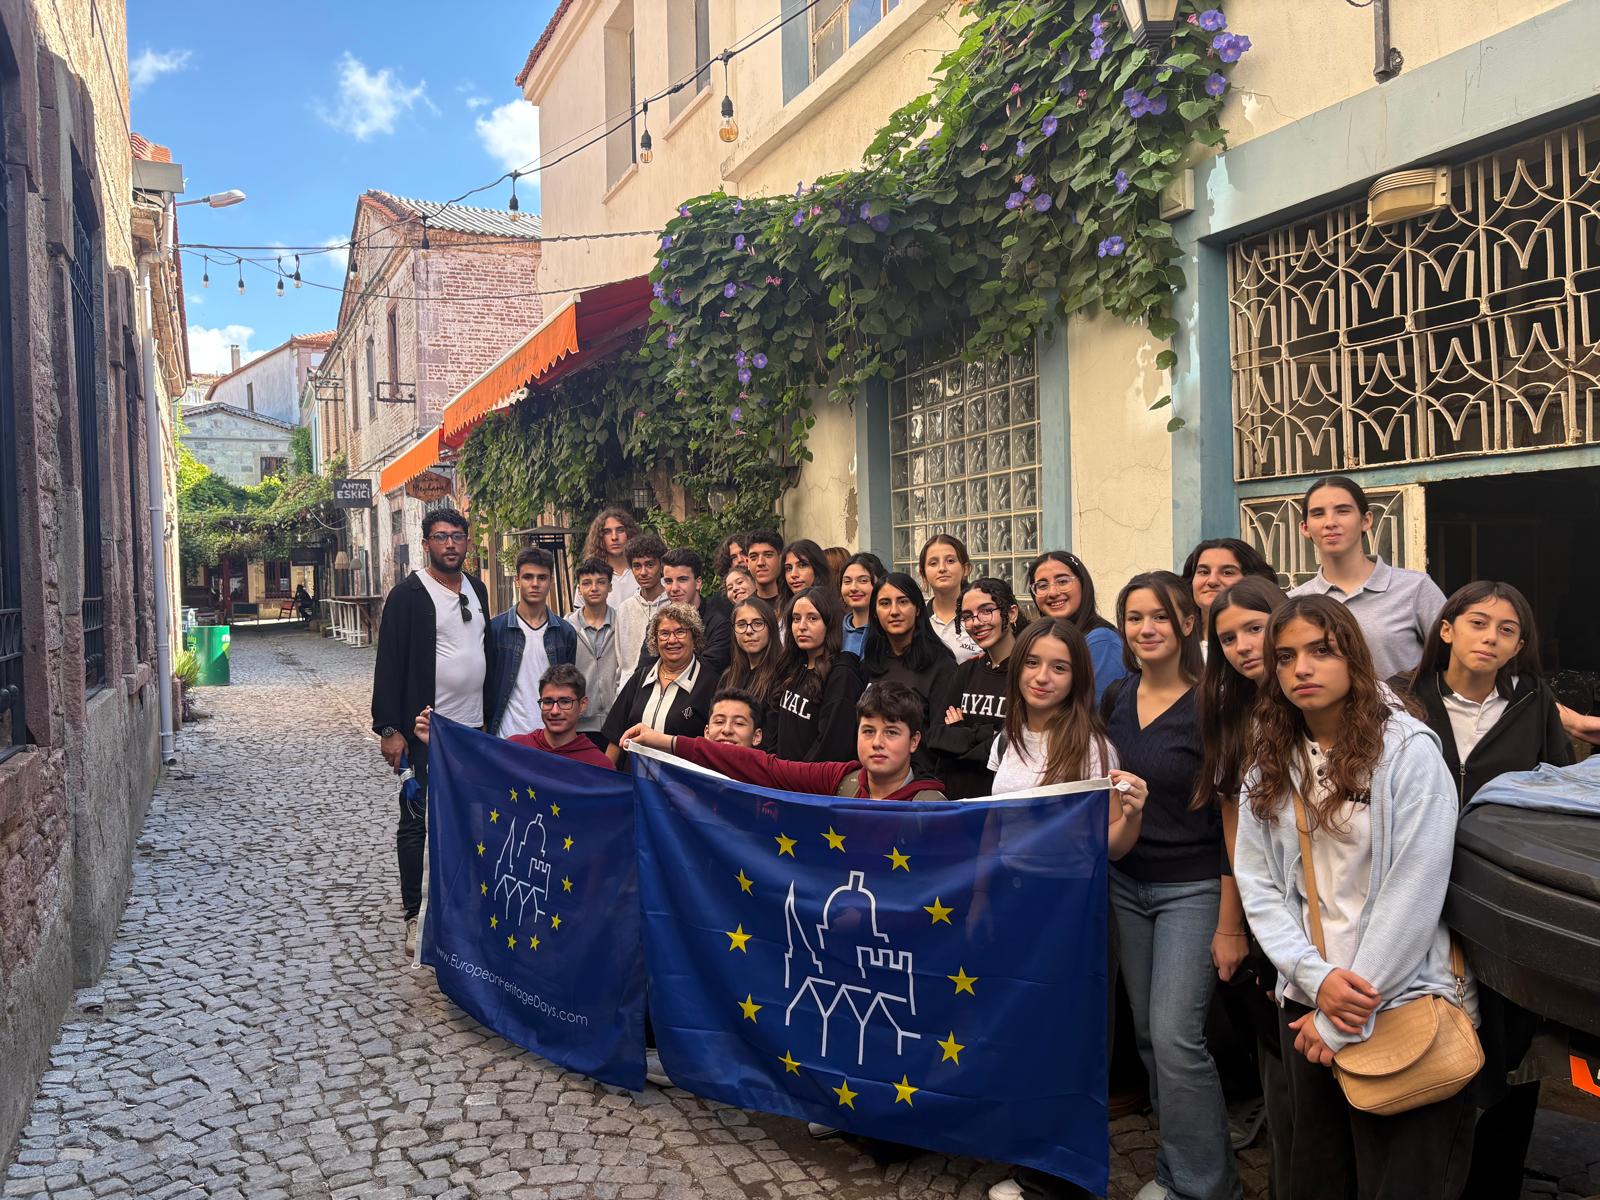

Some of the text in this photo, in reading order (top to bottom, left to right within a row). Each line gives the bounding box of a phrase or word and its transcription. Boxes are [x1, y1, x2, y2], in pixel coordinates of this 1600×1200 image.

[959, 643, 976, 652] AYAL
[780, 690, 811, 720] YAL
[961, 692, 1007, 718] AYAL
